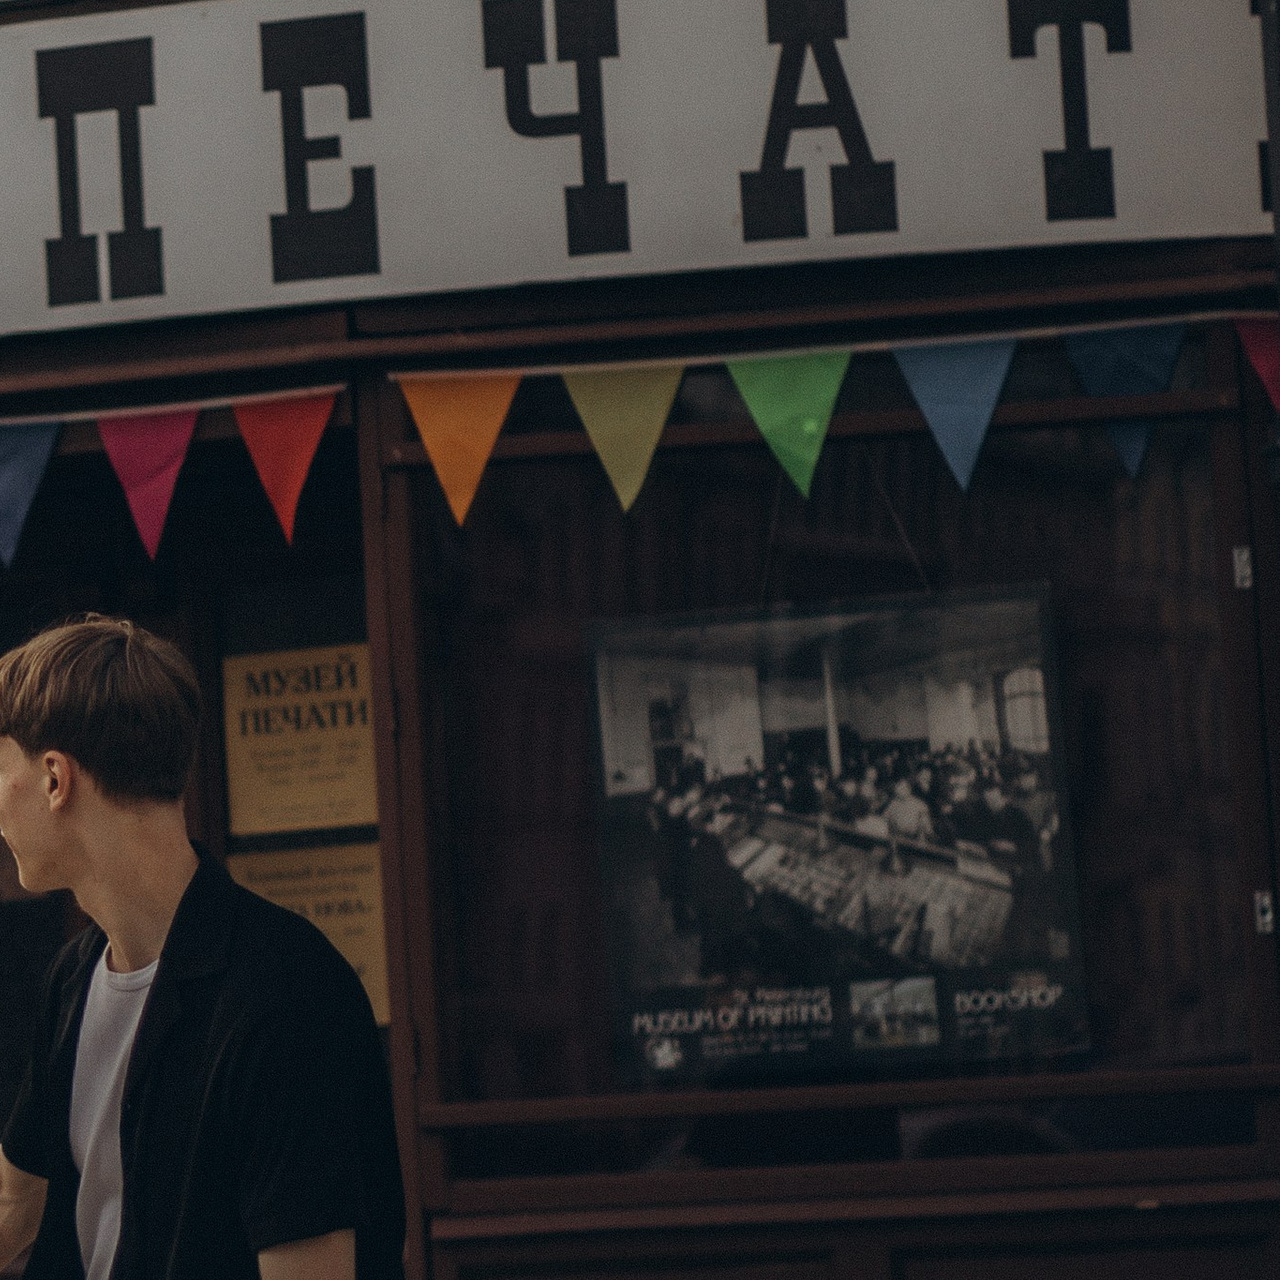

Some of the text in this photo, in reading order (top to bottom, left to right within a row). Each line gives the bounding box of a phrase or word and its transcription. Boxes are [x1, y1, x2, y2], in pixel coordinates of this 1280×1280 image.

[246, 653, 358, 698] МУЗЕЙ
[238, 699, 369, 737] ПЕЧАТИ
[632, 1009, 714, 1035] MUSEUM
